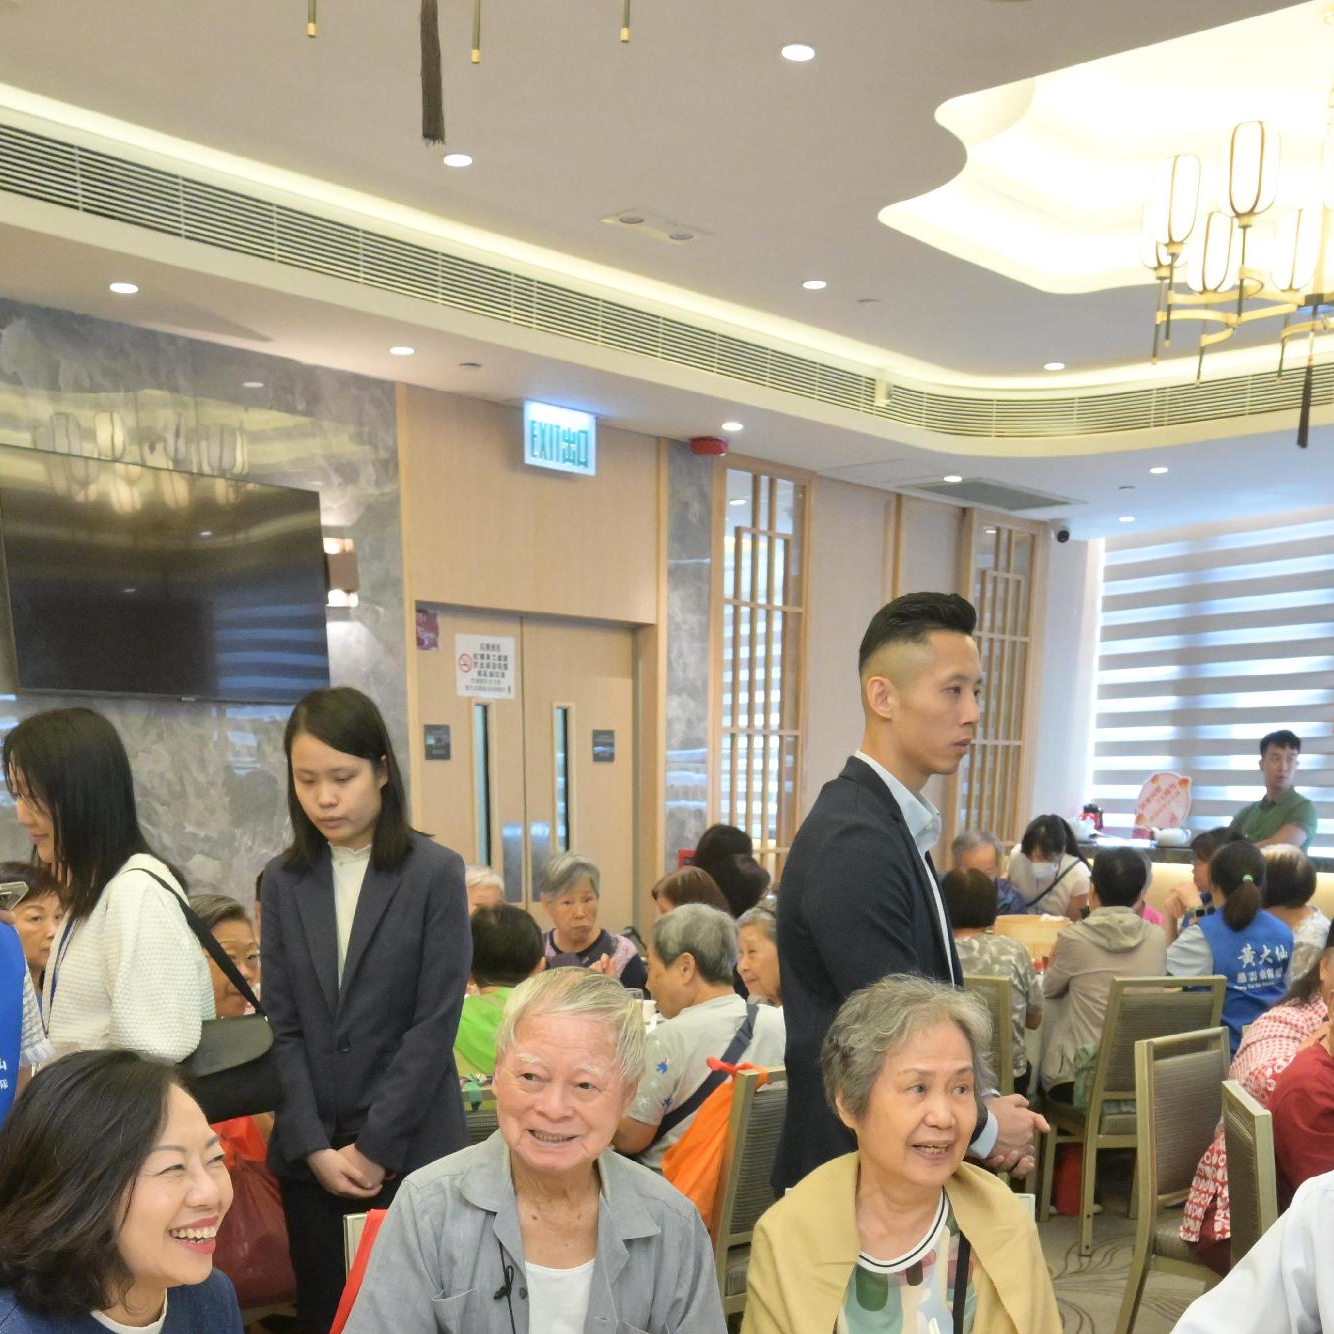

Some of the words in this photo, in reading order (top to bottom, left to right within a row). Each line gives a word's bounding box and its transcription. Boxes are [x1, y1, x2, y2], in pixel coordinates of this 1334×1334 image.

[530, 419, 560, 463] EXIT
[561, 427, 589, 469] 出口
[1237, 943, 1288, 968] 黃大仙
